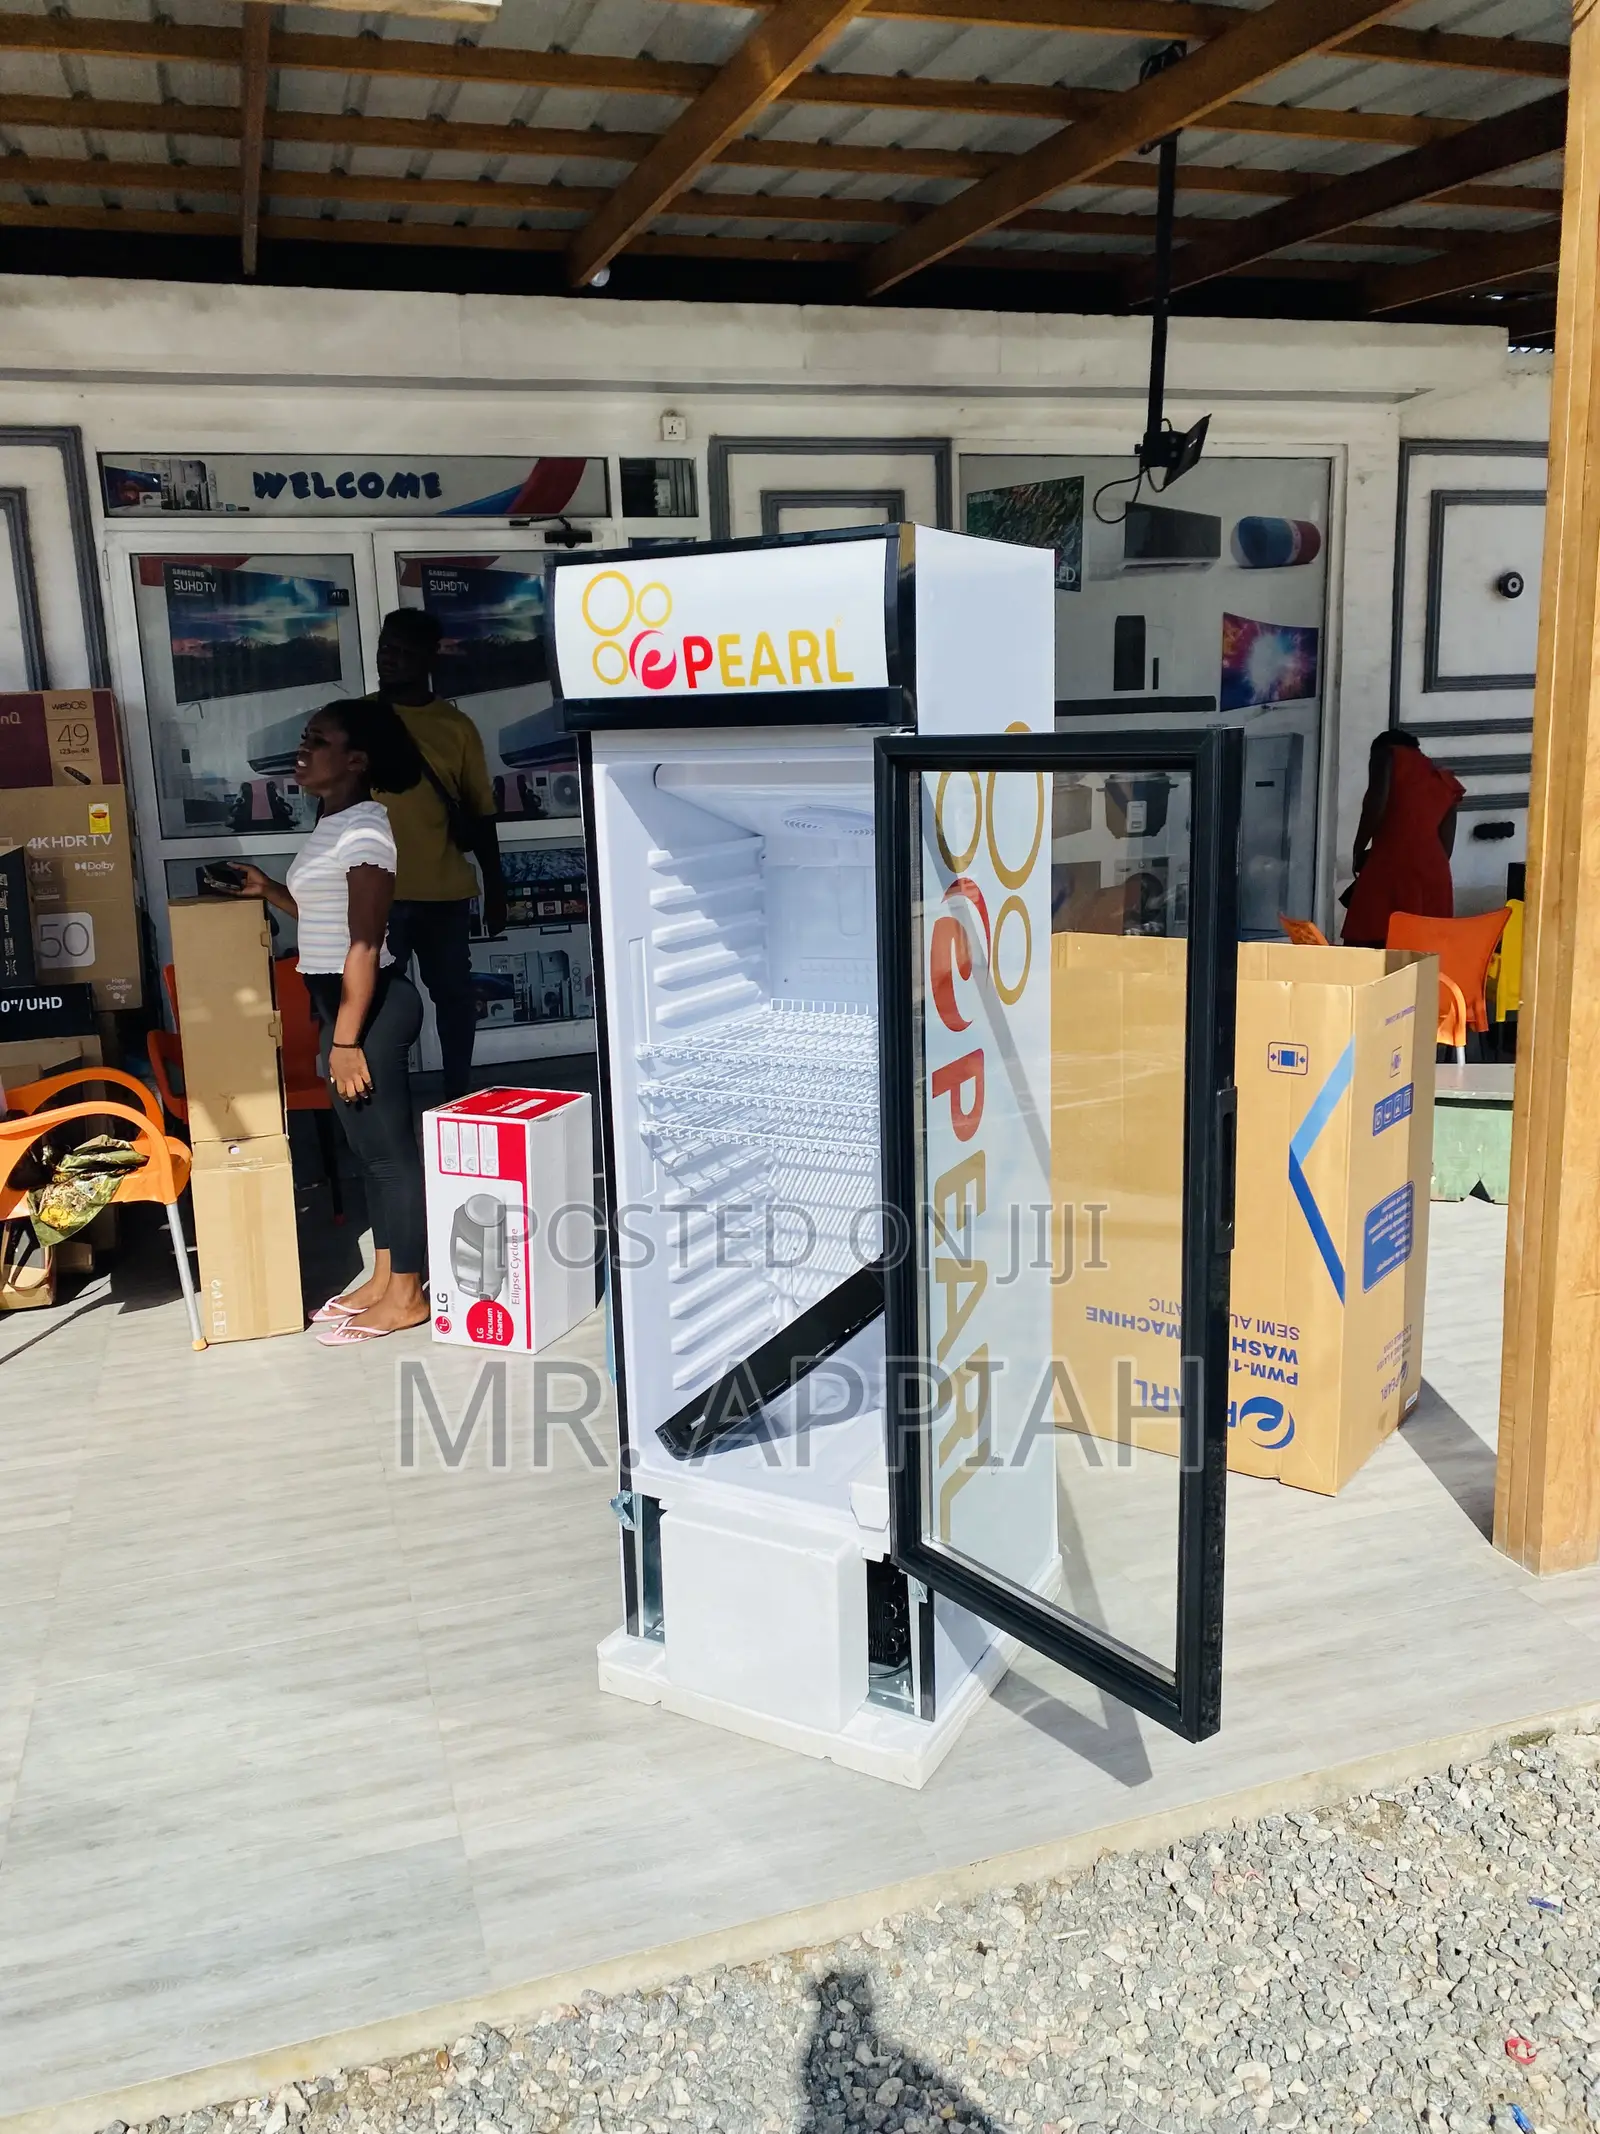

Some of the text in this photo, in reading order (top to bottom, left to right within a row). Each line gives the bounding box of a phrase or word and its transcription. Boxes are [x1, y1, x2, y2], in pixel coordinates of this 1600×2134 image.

[252, 471, 443, 499] WELCOME
[682, 627, 854, 689] PEARL
[52, 701, 87, 710] webOS
[0, 712, 22, 724] nQ
[57, 723, 90, 747] 49
[27, 837, 49, 849] 4K
[87, 861, 115, 871] Dolby
[39, 921, 90, 958] 50
[510, 1228, 521, 1305] Ellipse Cyclone
[437, 1292, 449, 1313] LG
[931, 1050, 991, 1544] PEARL
[476, 1327, 484, 1339] LG
[1085, 1305, 1299, 1365] WASH MACHINE
[1257, 1319, 1301, 1341] SEMI
[1228, 1358, 1299, 1386] PWM-1
